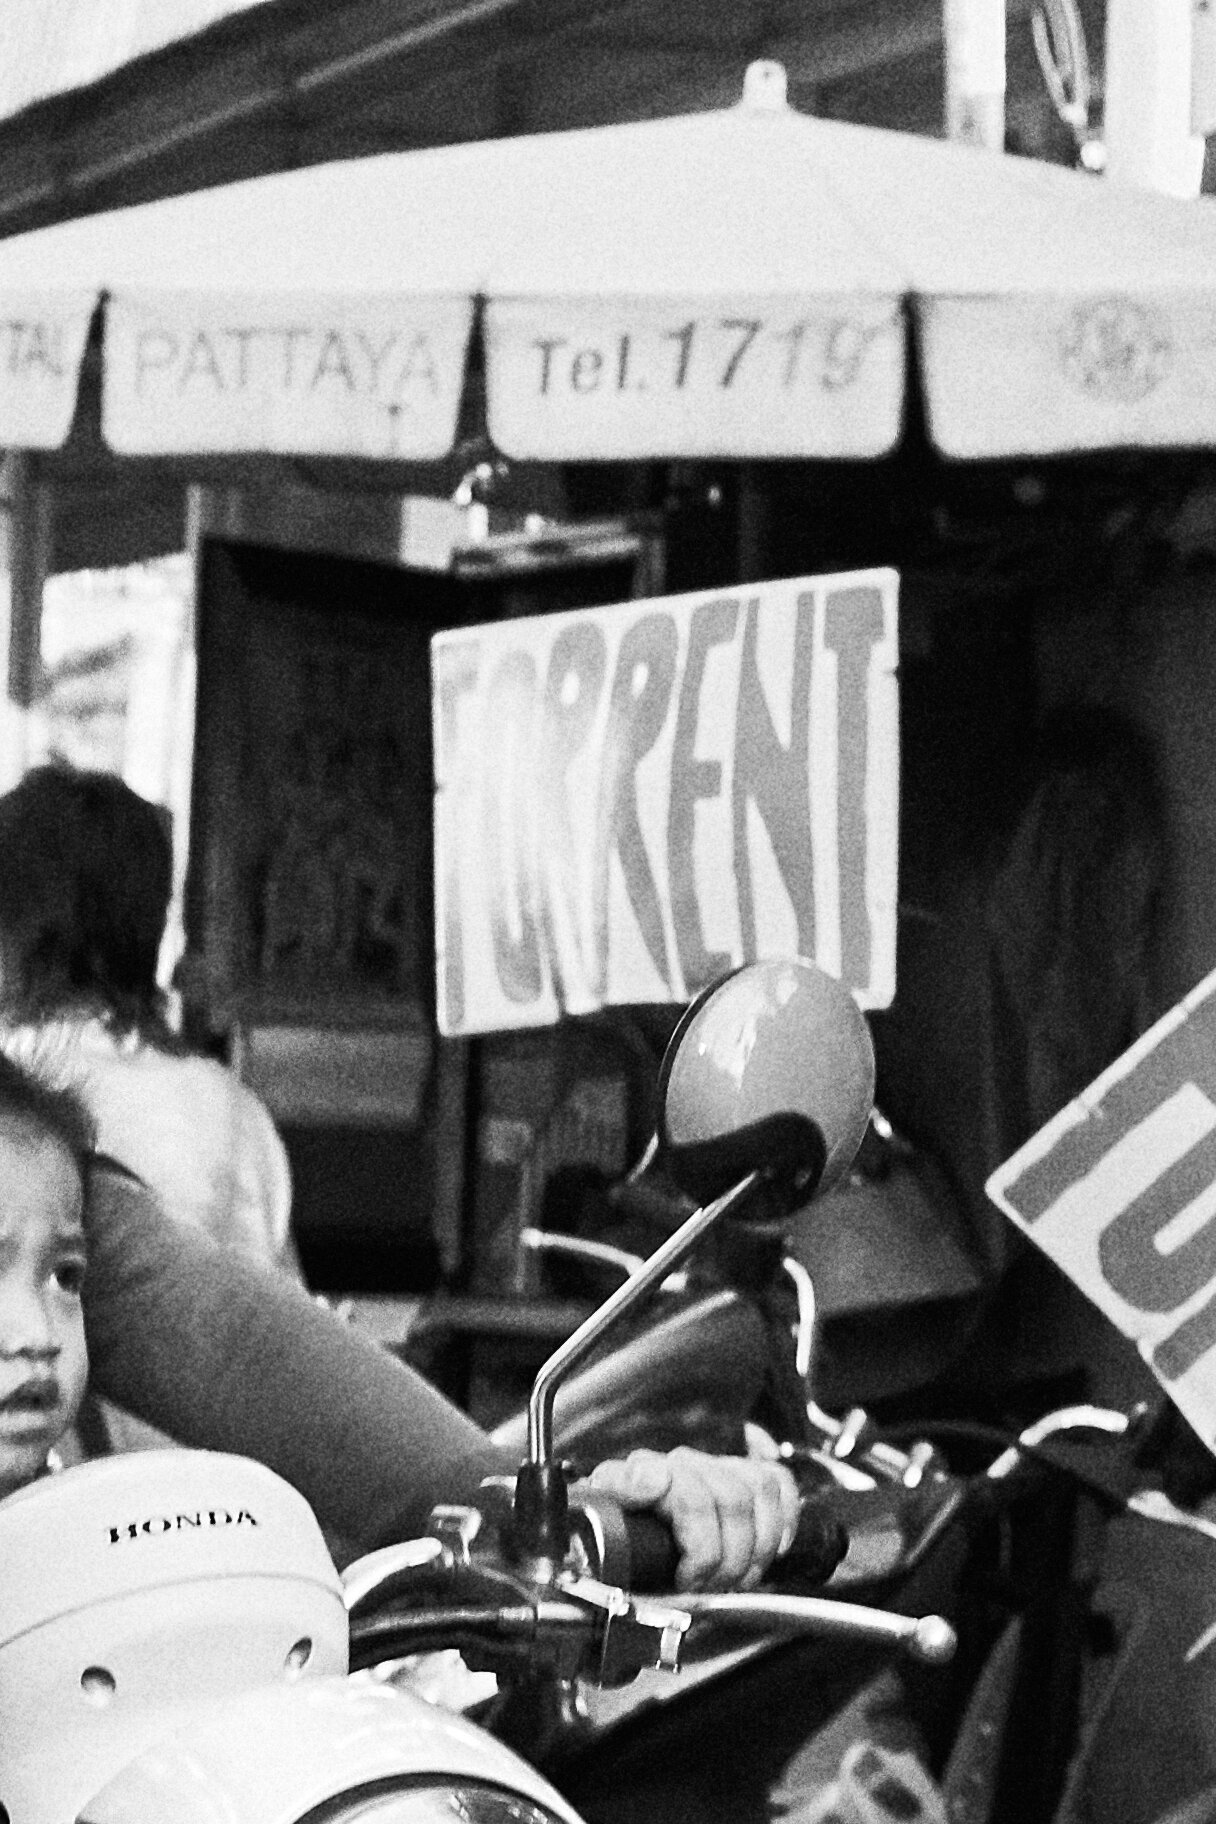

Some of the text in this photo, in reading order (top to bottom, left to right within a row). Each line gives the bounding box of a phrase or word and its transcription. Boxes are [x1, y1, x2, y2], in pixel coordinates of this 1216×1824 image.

[135, 324, 441, 397] PATTAYA
[592, 585, 887, 1001] RENT
[107, 1509, 259, 1543] HONDA
